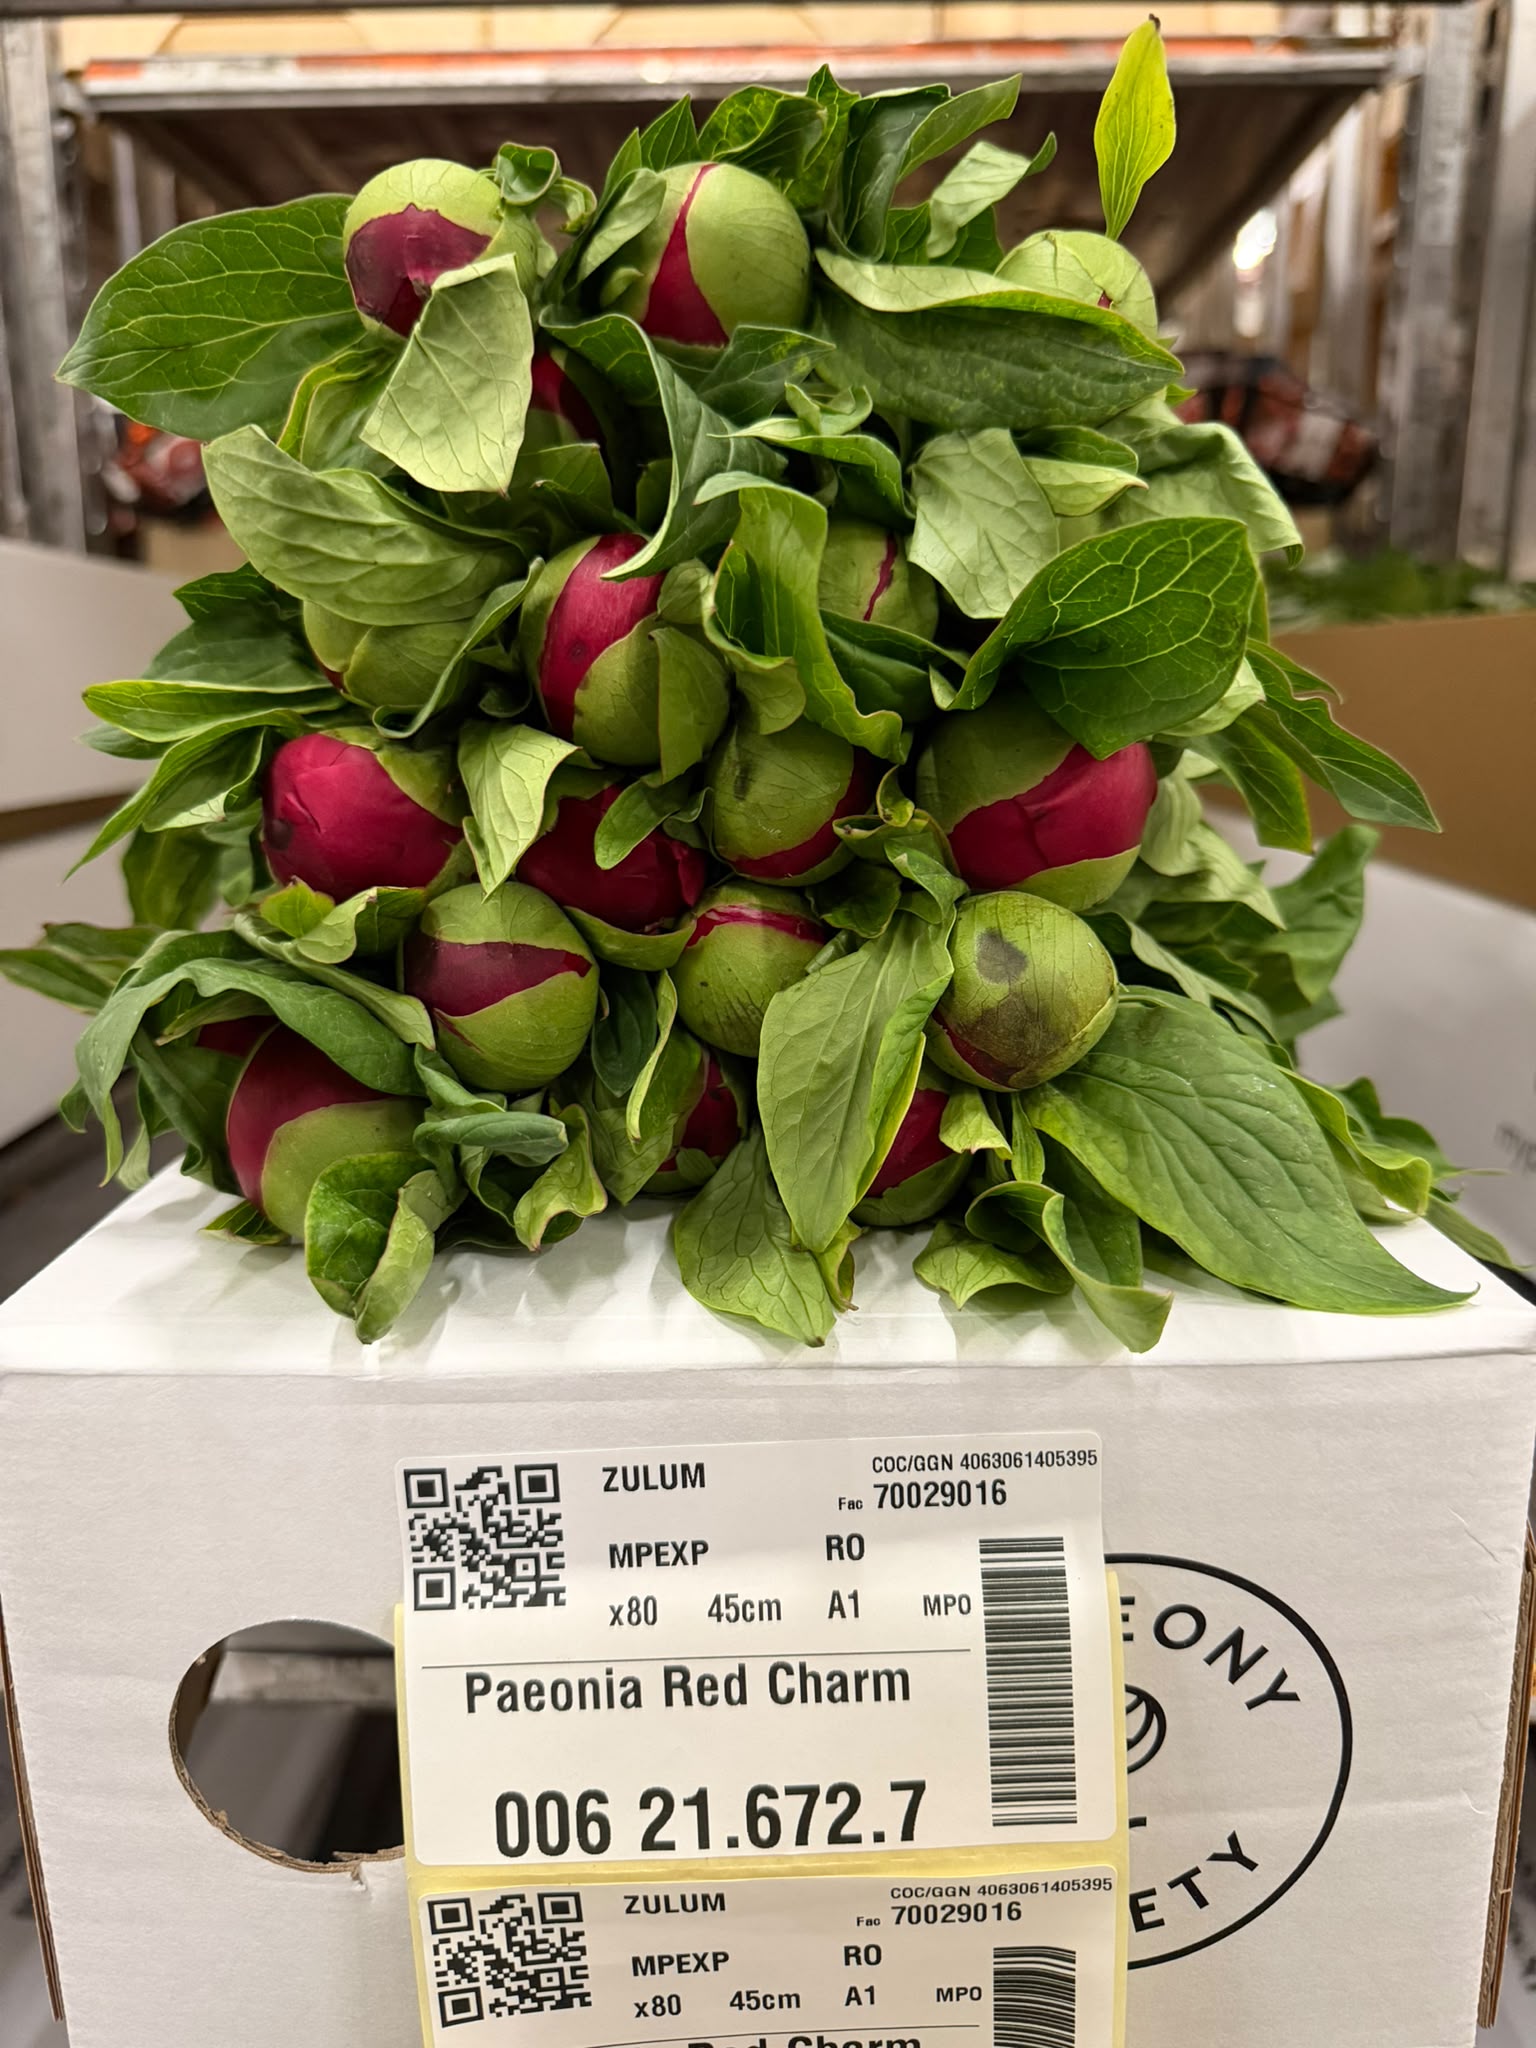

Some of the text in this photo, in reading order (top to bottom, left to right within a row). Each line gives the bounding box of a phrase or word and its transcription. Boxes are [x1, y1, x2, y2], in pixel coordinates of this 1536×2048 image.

[602, 1462, 707, 1493] ZULUM
[872, 1449, 1098, 1474] COC/GGN 4063061405395
[838, 1478, 1007, 1511] Fac 70029016
[609, 1533, 866, 1569] MPEXP RO
[609, 1589, 972, 1627] x80 45cm A1 MPO
[465, 1661, 911, 1715] Paeonia Red Charm
[495, 1779, 927, 1859] 006 21.672.7
[623, 1892, 727, 1915] ZULUM
[890, 1877, 1113, 1900] COC/GGN 4063061405395
[856, 1900, 1023, 1927] Fac 70029016
[631, 1943, 883, 1977] MPEXP RO
[634, 1985, 983, 2019] x80 45cm A1 MPO
